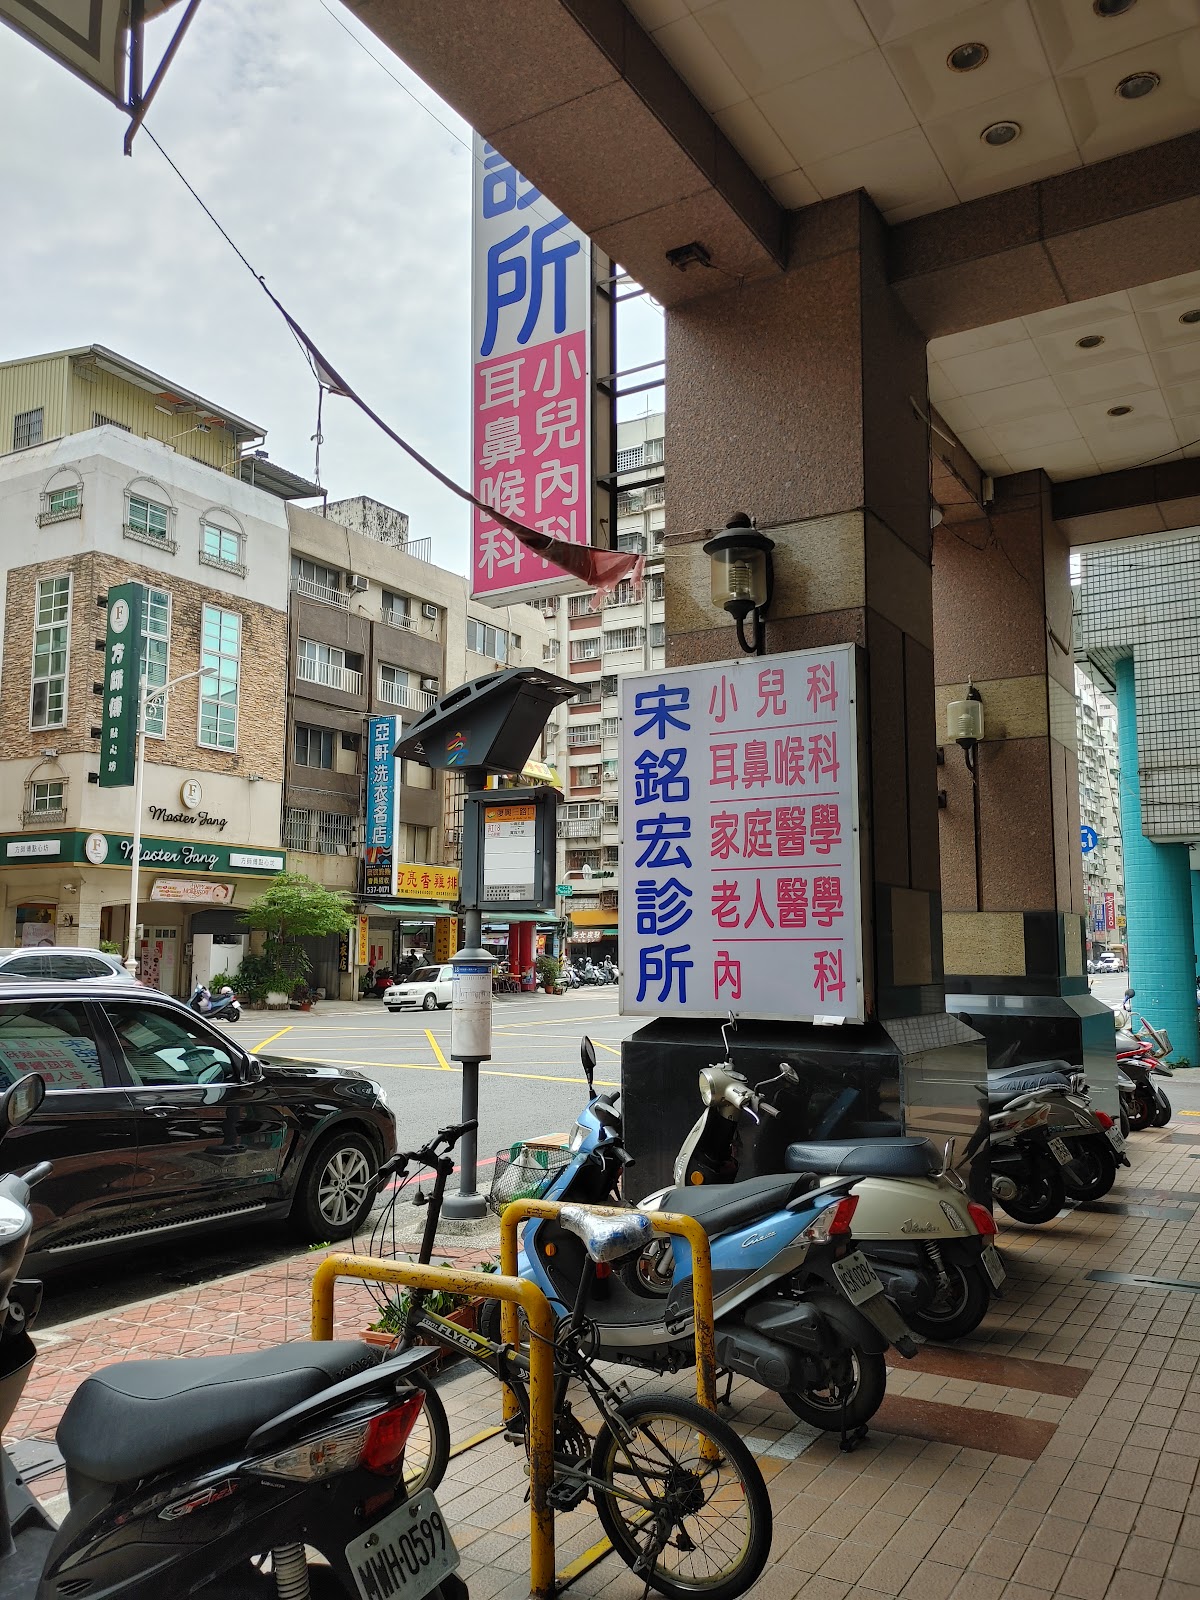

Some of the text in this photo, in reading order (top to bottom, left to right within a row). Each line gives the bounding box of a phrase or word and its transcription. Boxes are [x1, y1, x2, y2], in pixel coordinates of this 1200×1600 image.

[478, 356, 527, 580] 耳鼻喉科
[708, 660, 839, 724] 小兒科
[709, 731, 841, 792] 耳鼻喉科
[148, 805, 197, 824] Master
[634, 684, 694, 1004] 宋銘宏診所
[710, 803, 842, 860] 家庭醫學
[711, 875, 844, 929] 老人醫學
[438, 1323, 478, 1350] FLYER
